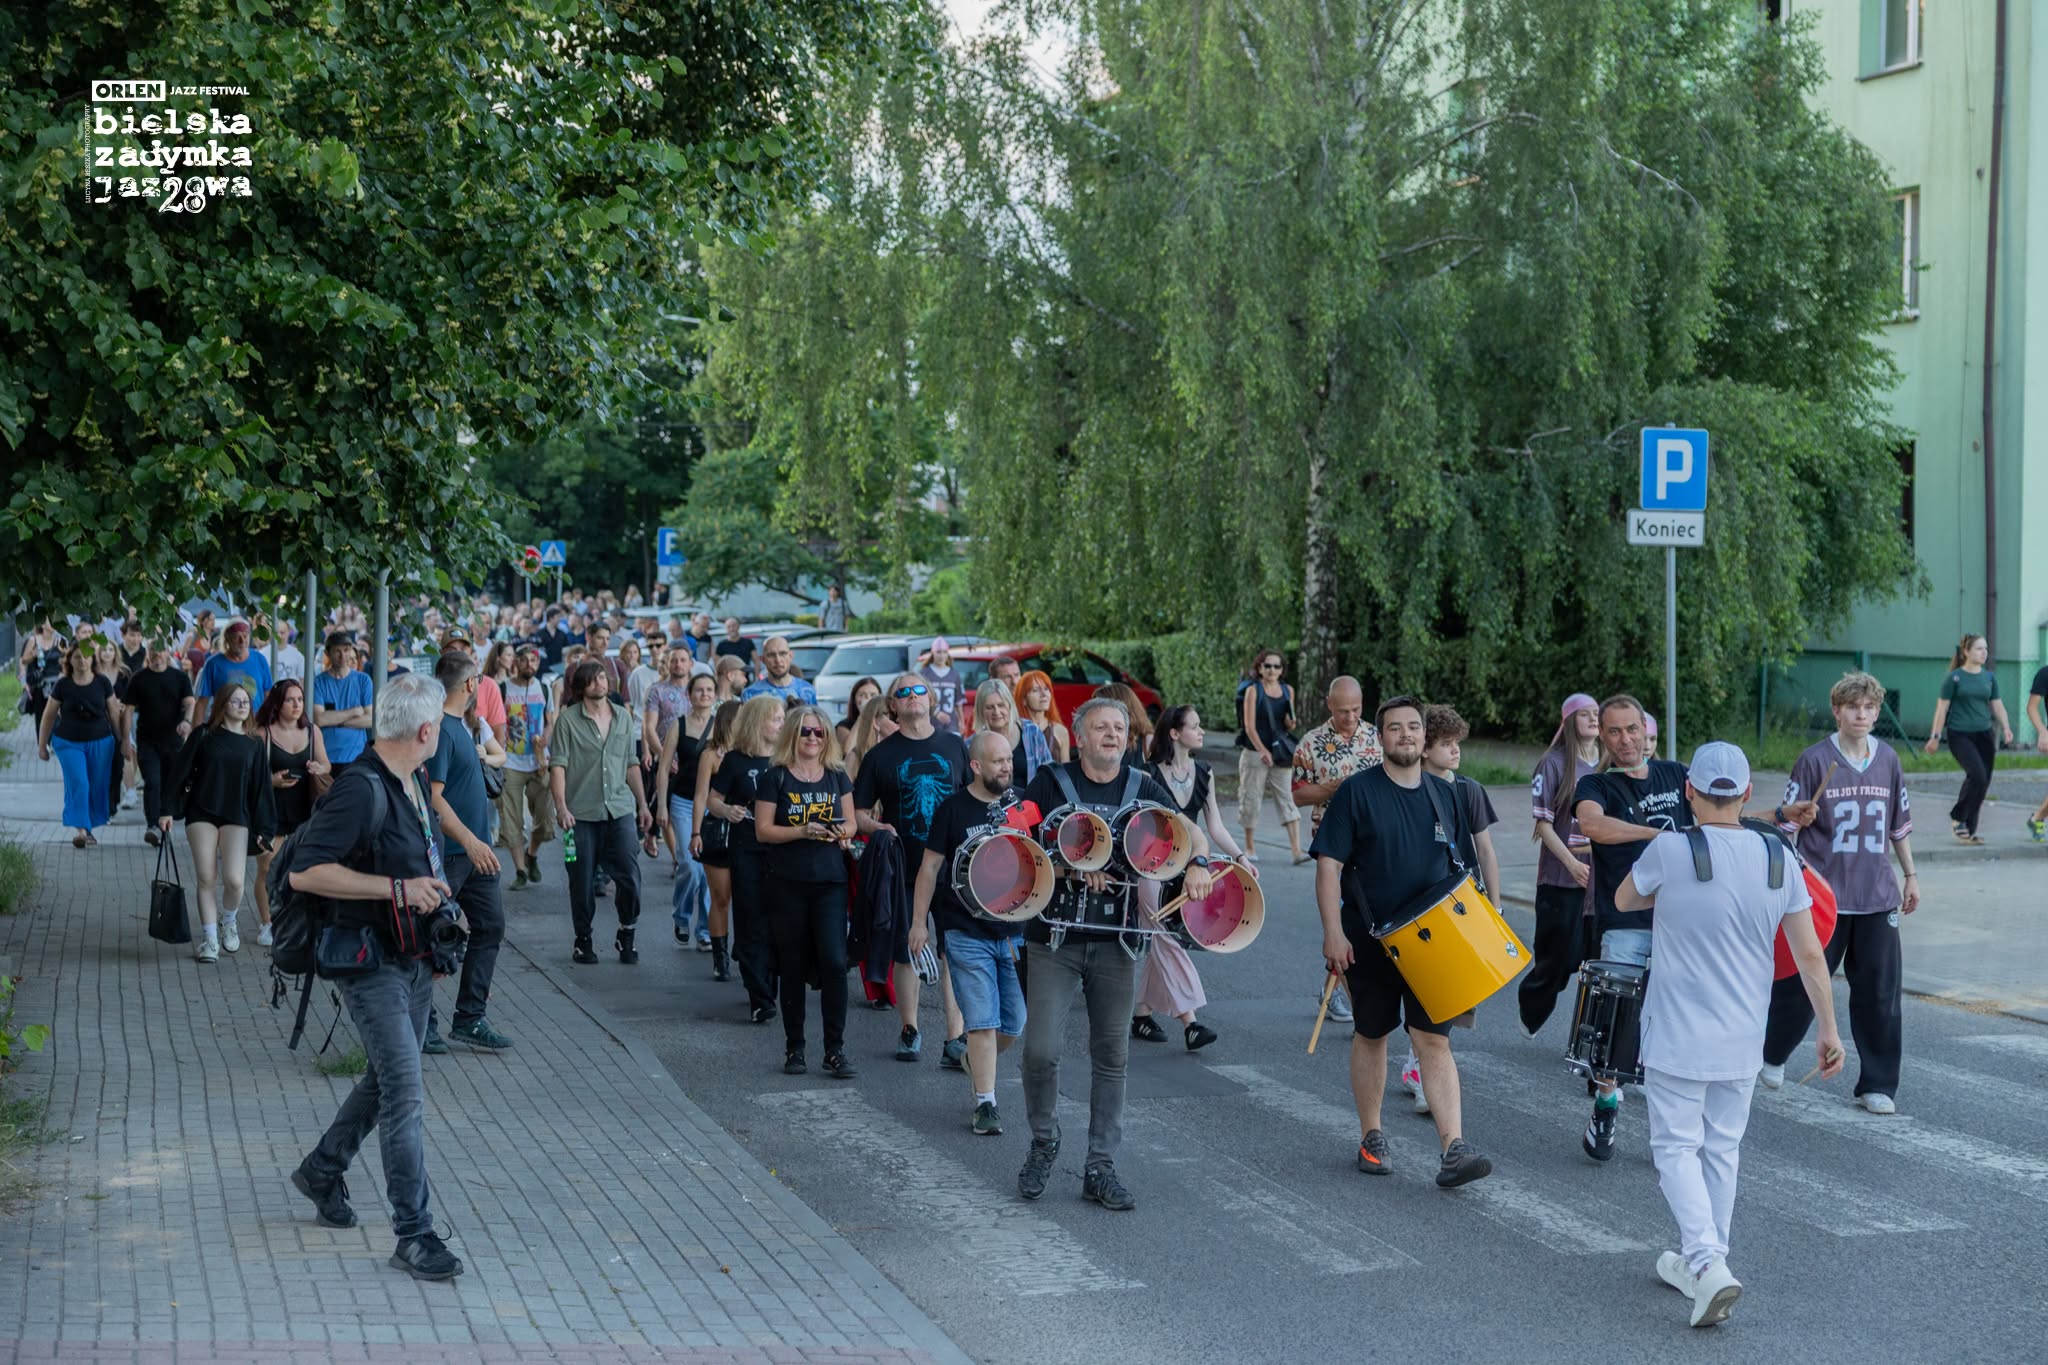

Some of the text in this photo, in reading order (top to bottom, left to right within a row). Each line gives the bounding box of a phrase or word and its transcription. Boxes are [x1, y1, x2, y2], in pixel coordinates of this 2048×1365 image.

[1656, 439, 1693, 500] P
[1637, 519, 1696, 538] Koniec
[1826, 786, 1858, 799] ENJOY
[1832, 800, 1887, 854] 23
